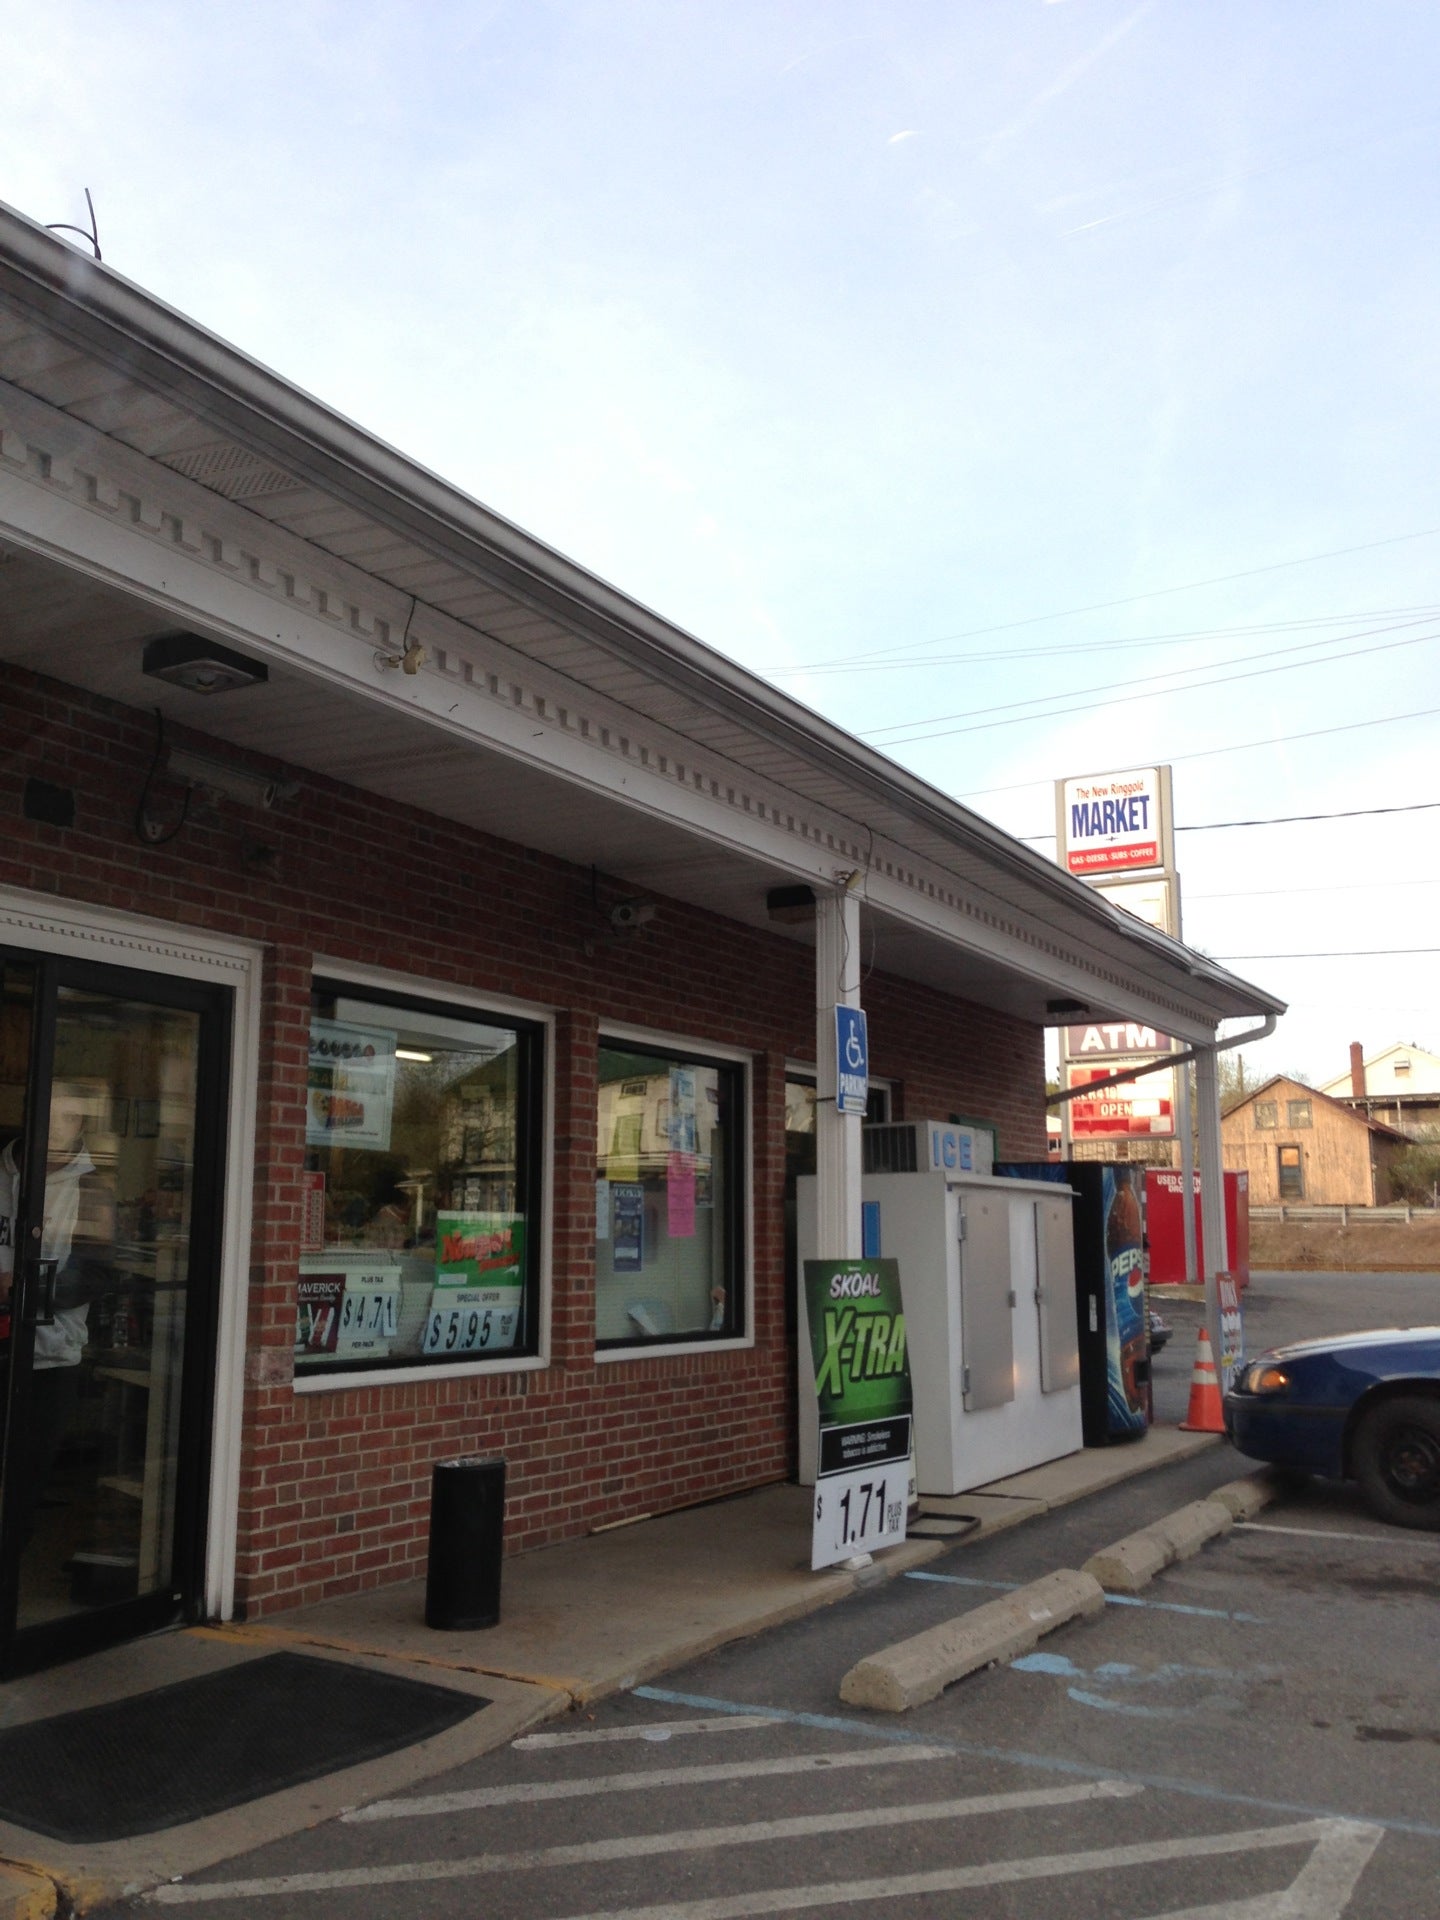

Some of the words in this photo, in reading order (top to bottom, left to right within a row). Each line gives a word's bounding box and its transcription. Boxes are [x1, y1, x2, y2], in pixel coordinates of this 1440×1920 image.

[1076, 788, 1089, 799] The
[1092, 786, 1108, 797] New
[1111, 780, 1144, 797] Ringgold
[1072, 795, 1149, 838] MARKET
[1080, 1023, 1156, 1051] ATM
[840, 1073, 866, 1096] PARKING
[1100, 1102, 1133, 1116] OPEN
[932, 1130, 972, 1170] ICE
[1157, 1175, 1177, 1185] USED
[829, 1272, 881, 1298] SKOAL
[457, 1294, 480, 1303] SPECIAL
[481, 1293, 500, 1302] OFFER
[816, 1309, 906, 1397] X-TRA
[887, 1501, 902, 1519] PLUS
